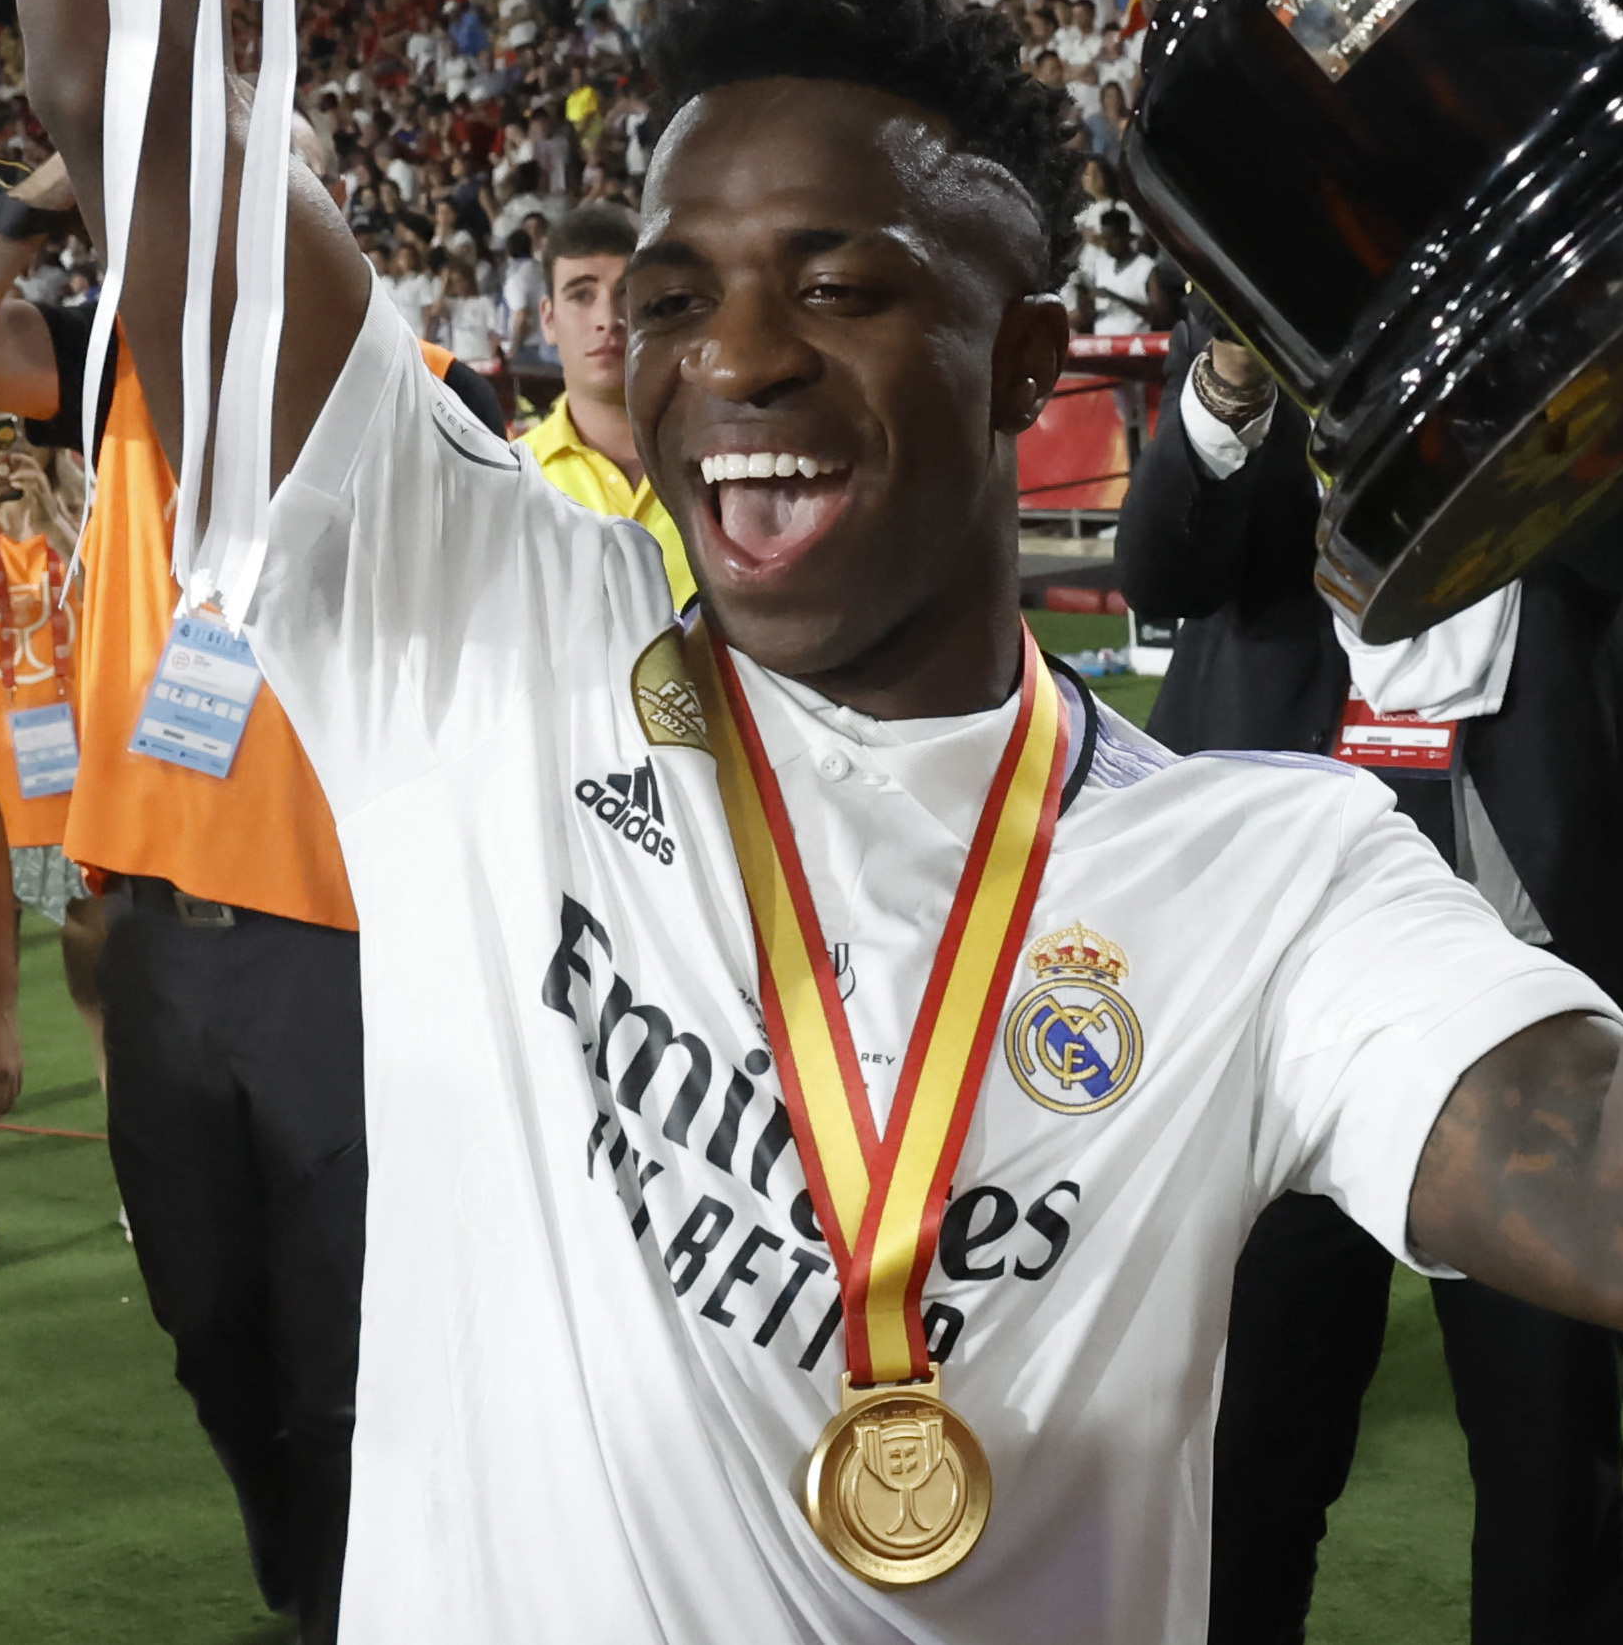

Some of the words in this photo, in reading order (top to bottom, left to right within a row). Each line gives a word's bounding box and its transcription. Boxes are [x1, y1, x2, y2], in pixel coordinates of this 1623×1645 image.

[637, 686, 669, 710] WORLD
[658, 680, 707, 735] FIFA
[650, 709, 687, 738] 2022
[574, 773, 677, 866] adidas
[860, 1052, 896, 1066] REY
[541, 890, 1081, 1283] Emires
